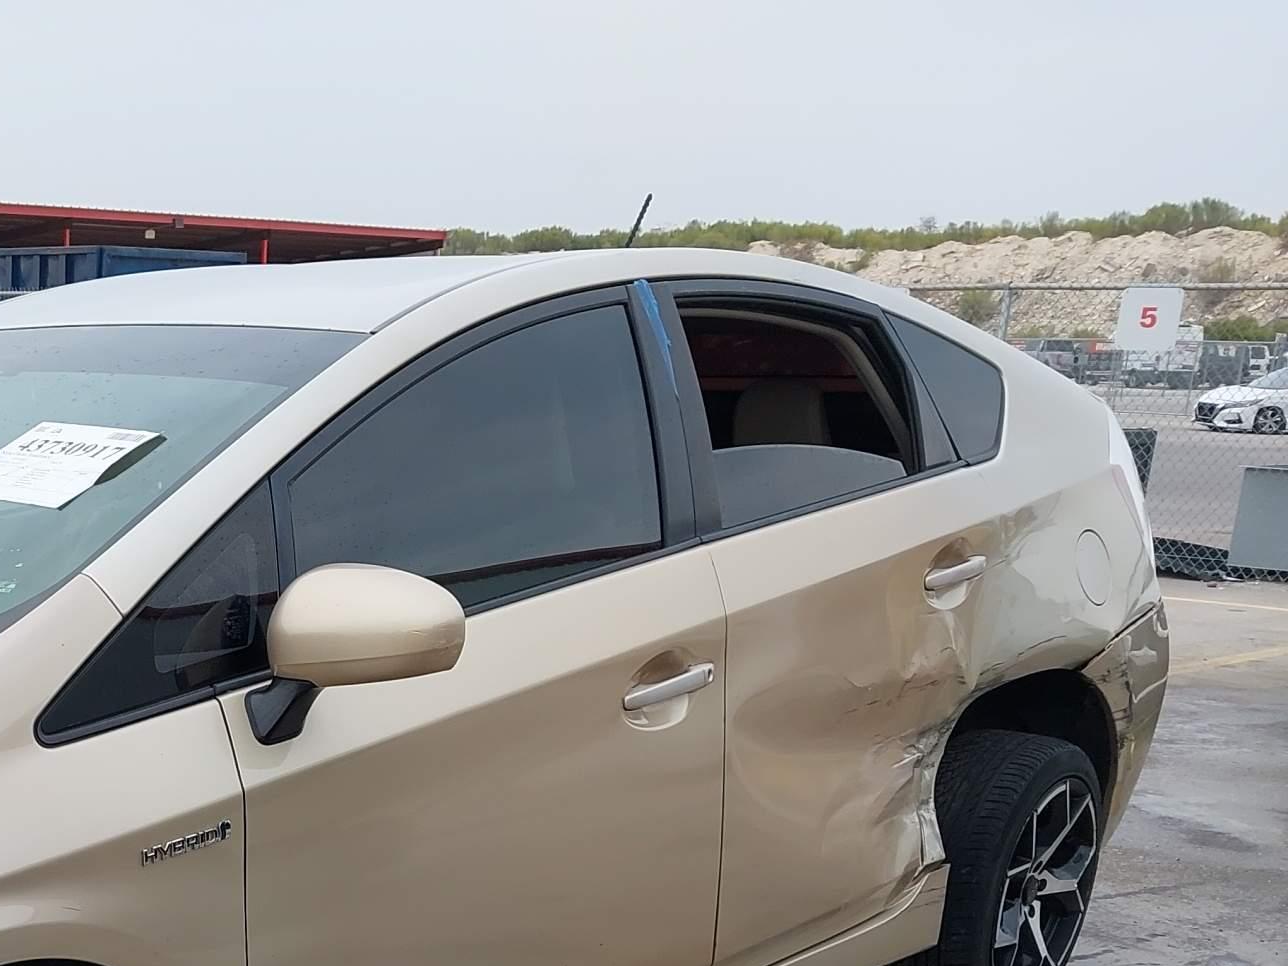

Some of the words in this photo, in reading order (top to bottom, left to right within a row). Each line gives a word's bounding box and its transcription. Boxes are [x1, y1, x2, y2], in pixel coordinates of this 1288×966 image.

[1139, 306, 1158, 328] 5
[18, 437, 128, 461] 43730917
[141, 827, 219, 867] HYBRID
